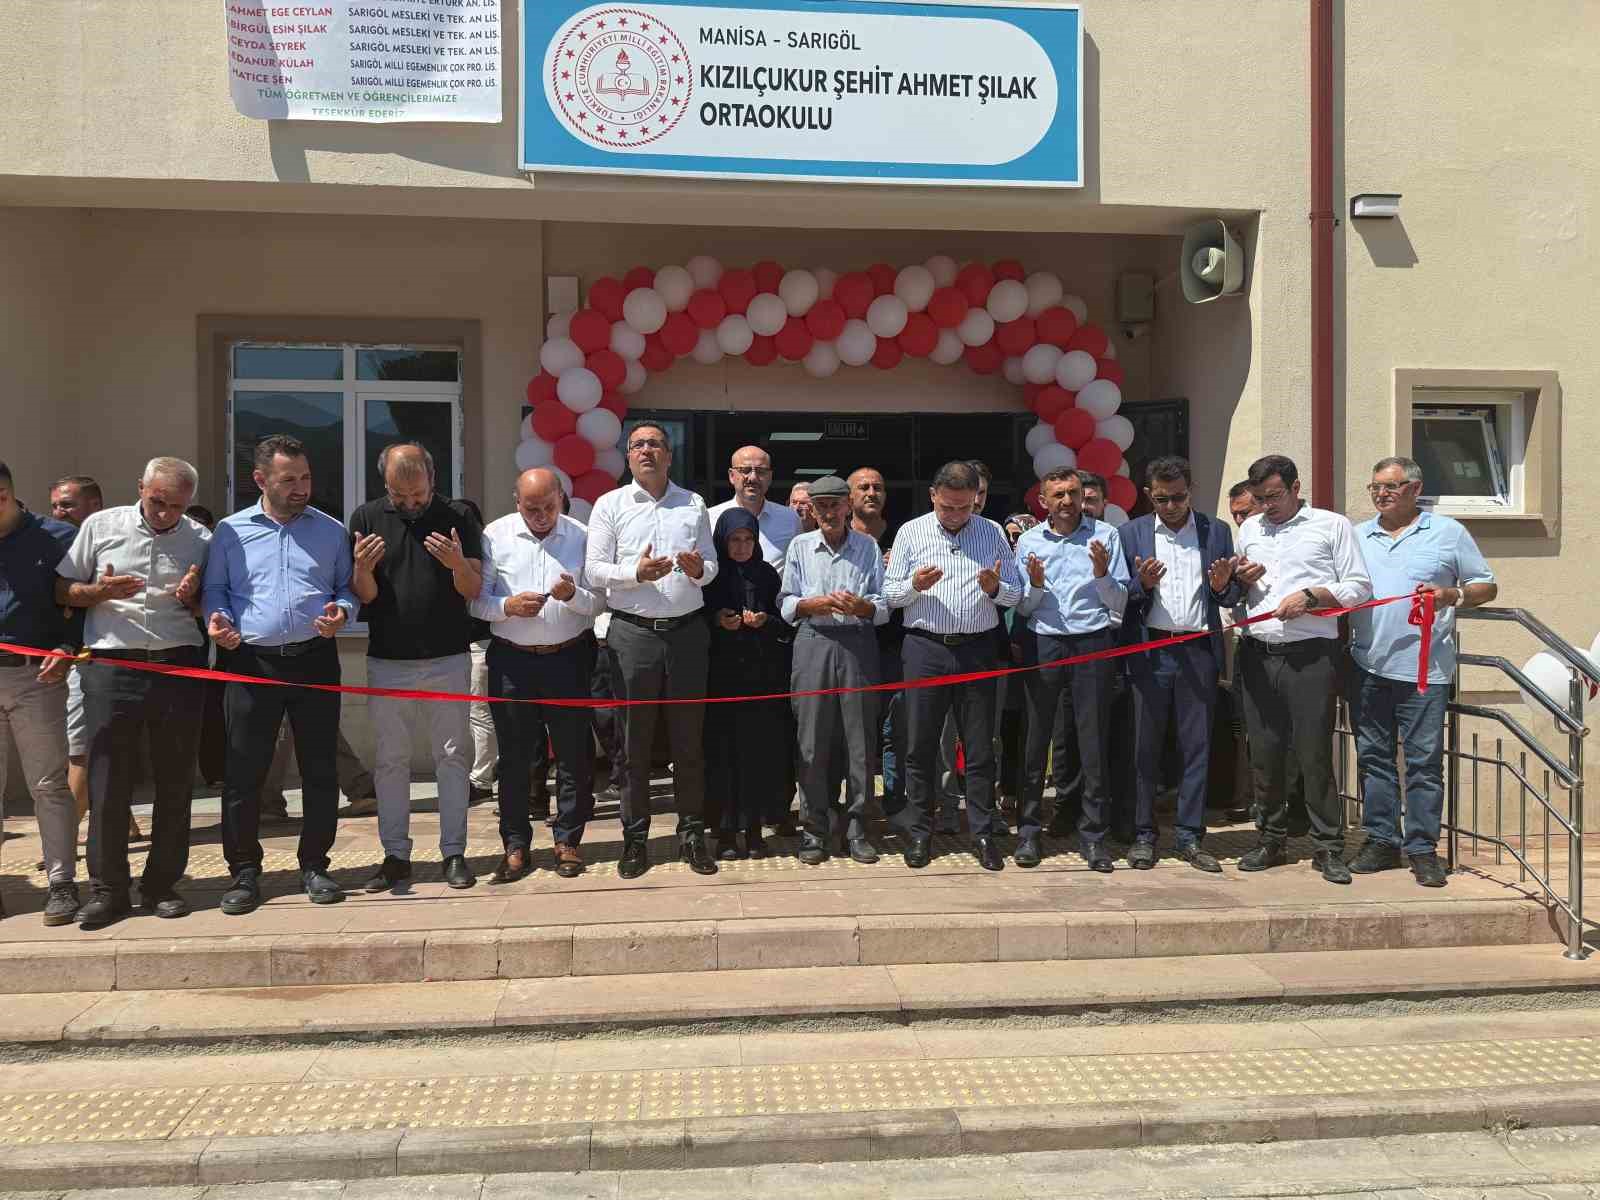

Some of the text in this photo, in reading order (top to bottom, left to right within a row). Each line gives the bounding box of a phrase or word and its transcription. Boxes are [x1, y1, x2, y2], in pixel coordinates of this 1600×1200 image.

[230, 5, 332, 17] AHMET EGE CEYLAN
[348, 7, 389, 18] SARIGÖL
[391, 10, 430, 21] MESLEKİ
[433, 13, 445, 22] VE
[447, 14, 467, 24] TEK.
[230, 19, 270, 34] BİRGÜL
[349, 24, 389, 36] SARIGÖL
[392, 27, 431, 38] MESLEKİ
[433, 30, 445, 40] VE
[448, 31, 467, 40] TEK.
[231, 35, 306, 51] CEYDA SEYREK
[699, 24, 767, 48] MANİSA
[787, 30, 861, 50] SARIGÖL
[349, 40, 390, 52] SARIGÖL
[393, 43, 431, 55] MESLEKİ
[433, 47, 445, 56] VE
[448, 48, 467, 56] TEK.
[231, 51, 277, 67] EDANUR
[350, 58, 382, 69] SARIGÖL
[449, 63, 465, 74] ÇOK
[232, 67, 270, 84] HATİCE
[351, 76, 383, 86] SARIGÖL
[449, 79, 465, 89] ÇOK
[700, 64, 1038, 104] KIZILÇUKUR ŞEHİT AHMET ŞILAK
[257, 88, 282, 99] TÜM
[286, 89, 344, 101] ÖĞRETMEN
[347, 92, 361, 101] VE
[700, 102, 833, 130] ORTAOKULU
